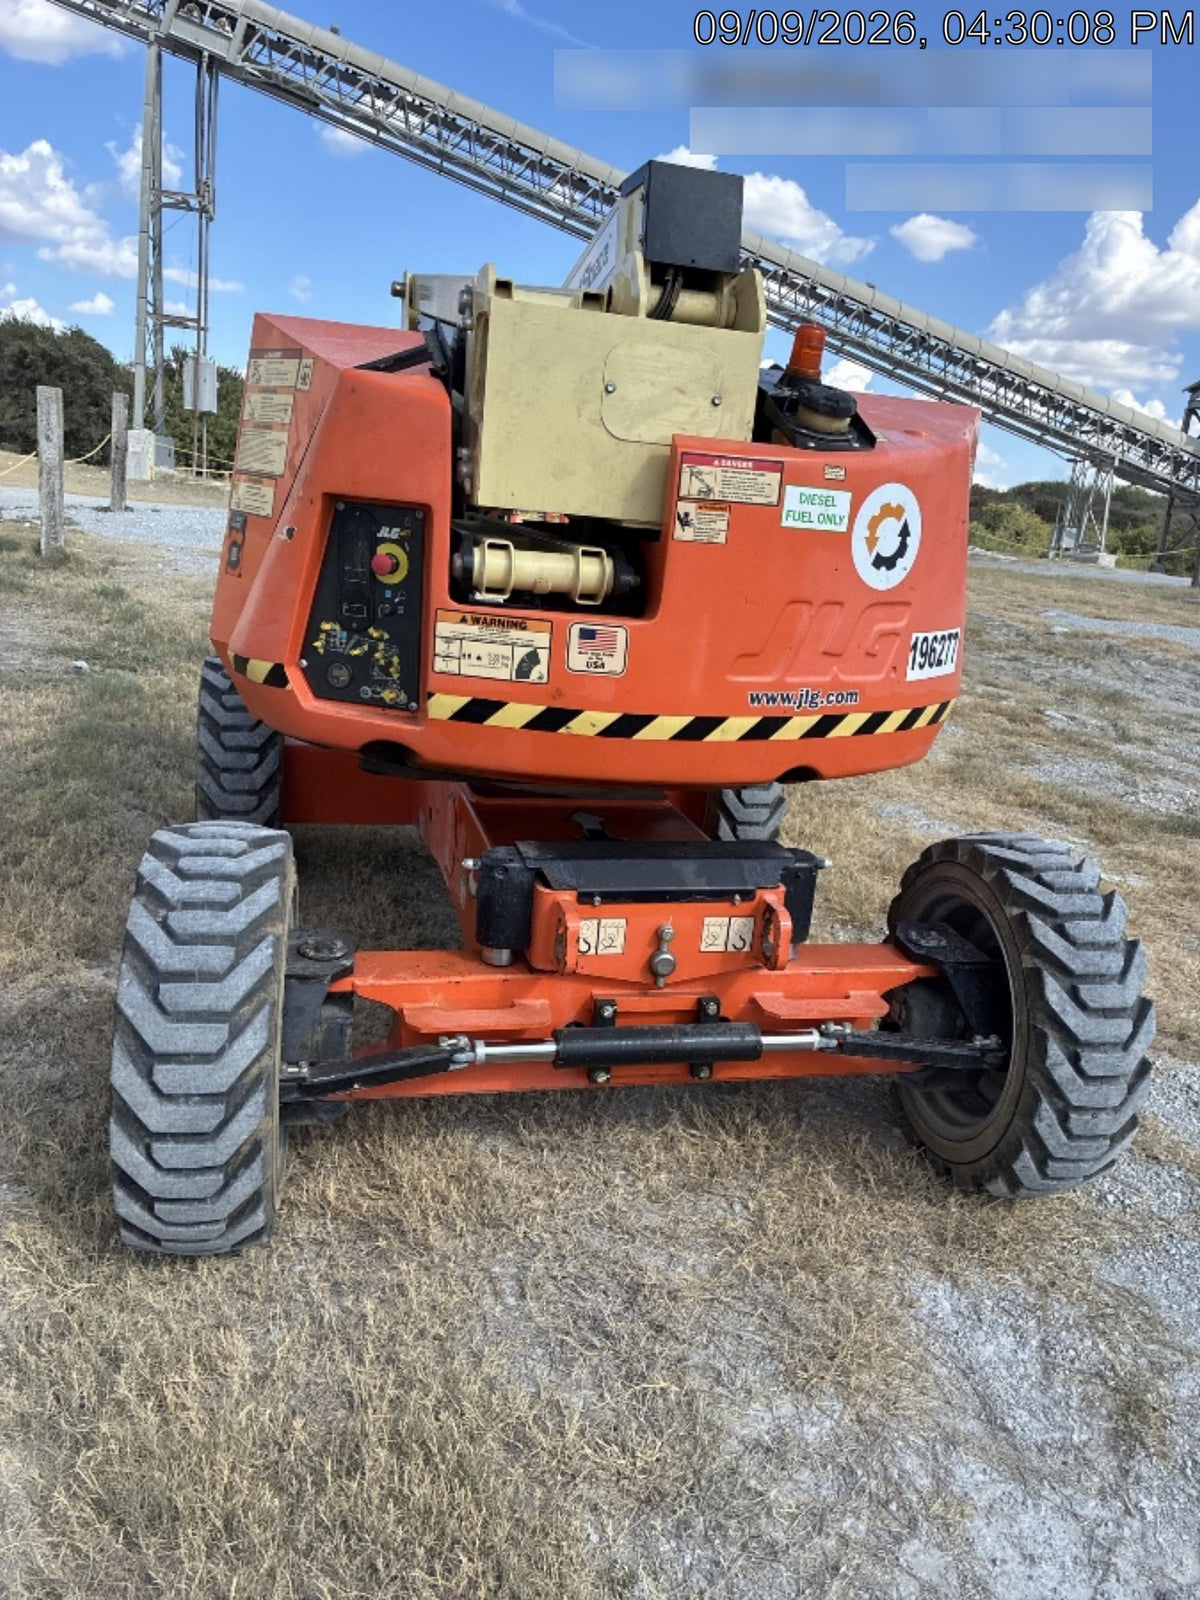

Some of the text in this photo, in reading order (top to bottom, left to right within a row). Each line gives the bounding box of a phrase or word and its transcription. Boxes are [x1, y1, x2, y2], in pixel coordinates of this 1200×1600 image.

[799, 492, 838, 508] DIESEL
[785, 509, 846, 526] FUEL ONLY
[376, 526, 400, 540] JLG
[470, 614, 528, 631] WARNING
[909, 631, 959, 672] 196277
[586, 660, 605, 670] USA
[748, 688, 859, 709] www.jlg.com
